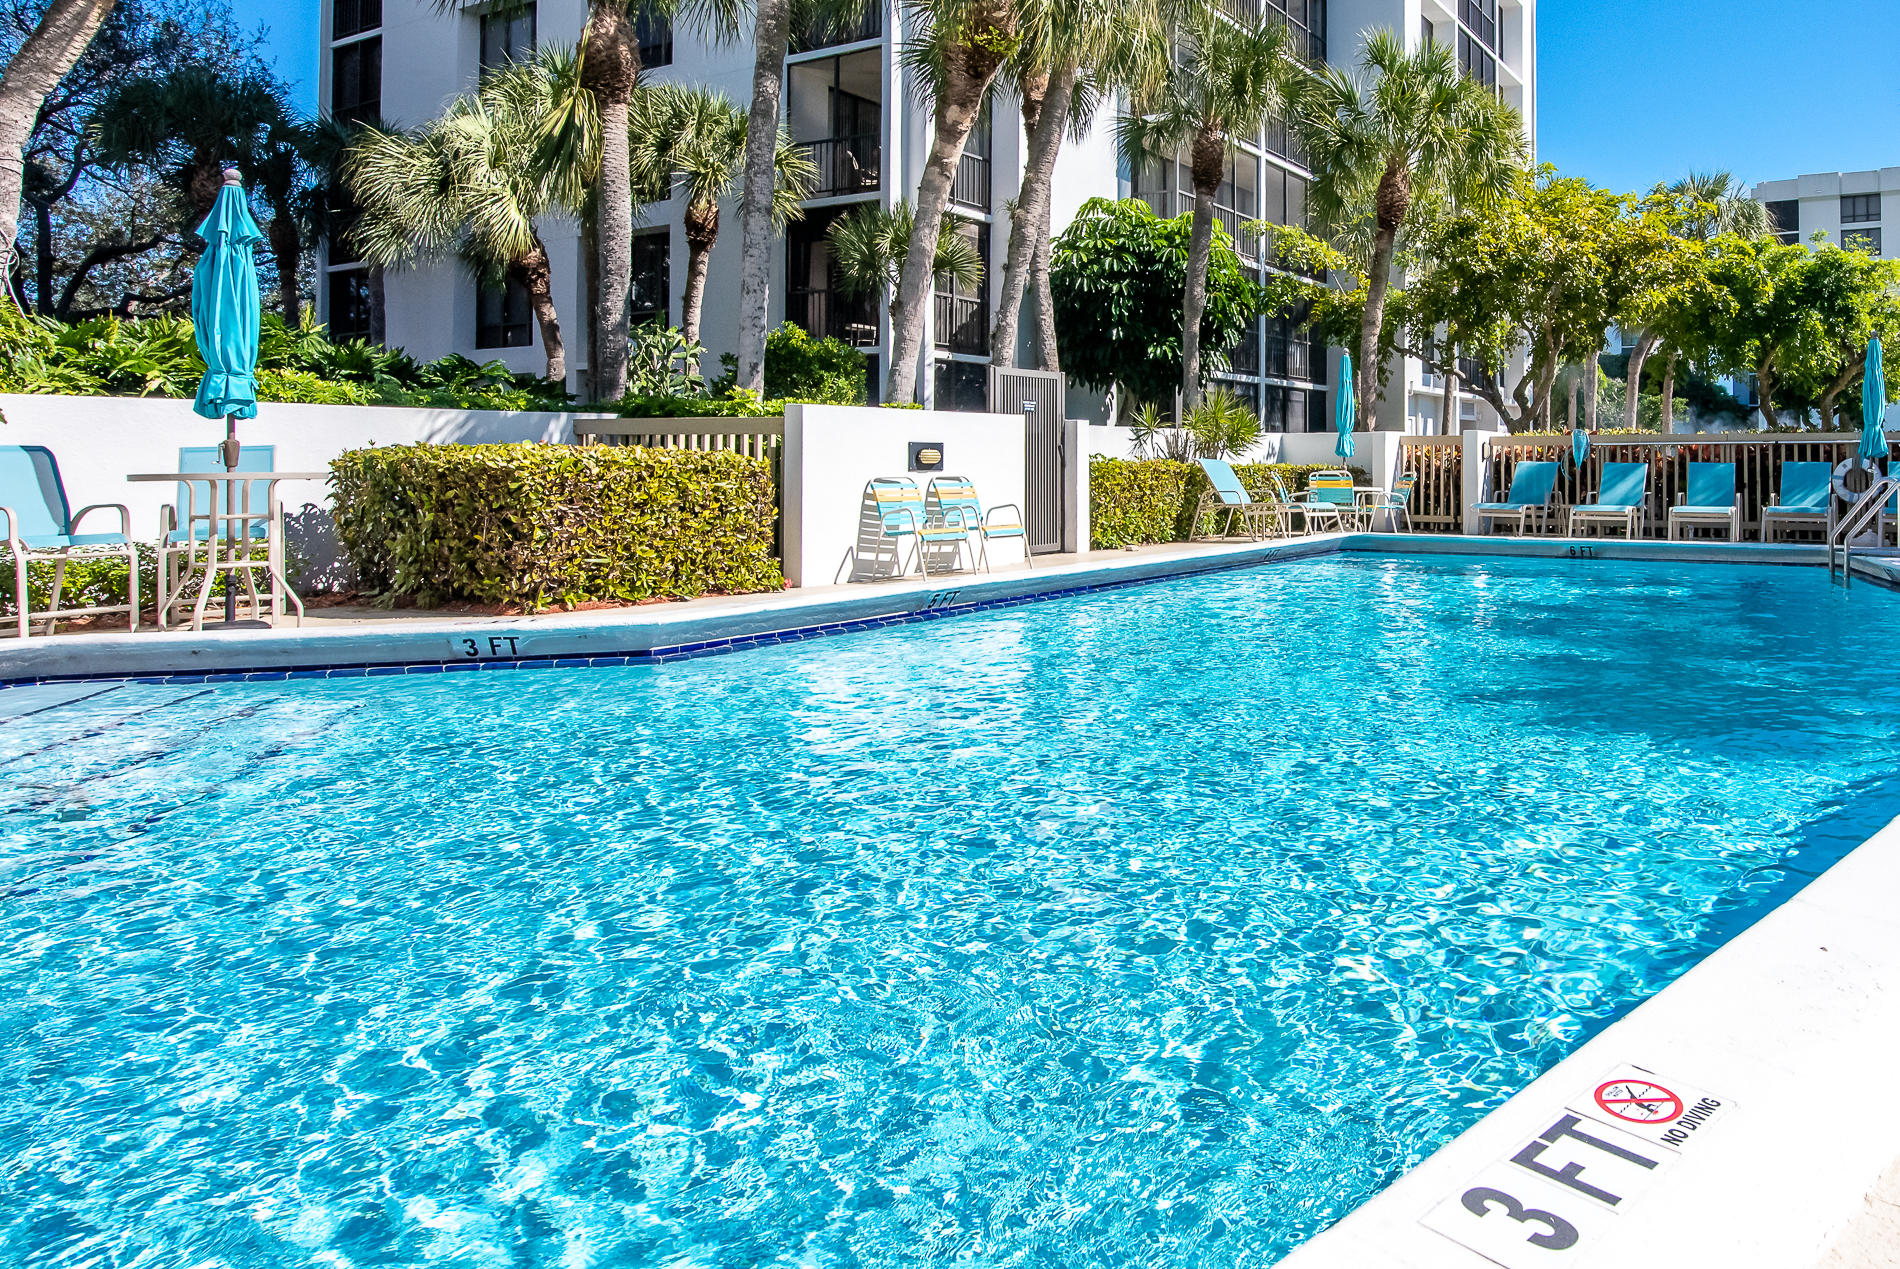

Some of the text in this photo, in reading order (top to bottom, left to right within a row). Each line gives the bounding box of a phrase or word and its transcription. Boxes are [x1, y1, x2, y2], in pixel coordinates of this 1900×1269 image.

[1570, 545, 1593, 557] 6 FT
[928, 590, 961, 608] 5 FT
[462, 636, 520, 657] 3 FT
[1659, 1097, 1722, 1147] NO DIVING
[1461, 1113, 1660, 1251] 3 FT
